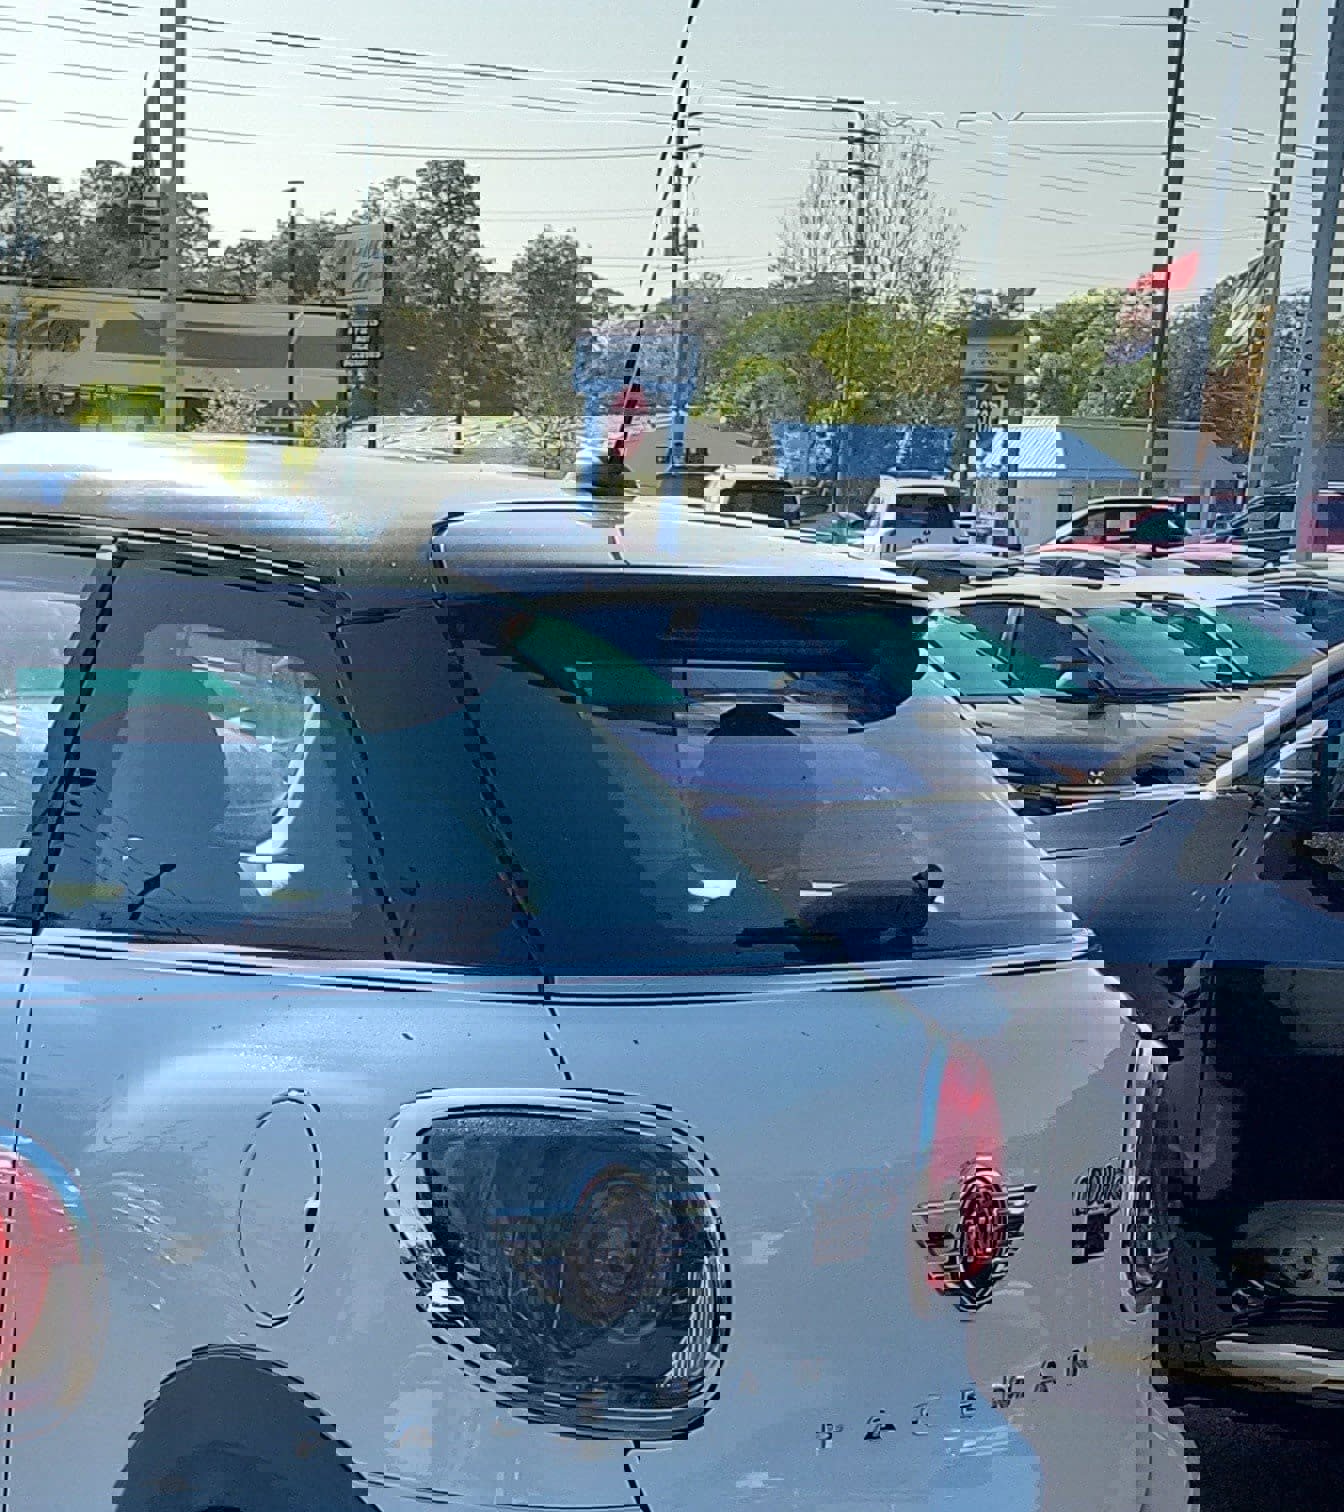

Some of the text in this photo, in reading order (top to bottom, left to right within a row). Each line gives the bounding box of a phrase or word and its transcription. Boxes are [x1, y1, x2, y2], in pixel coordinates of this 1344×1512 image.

[1246, 305, 1274, 443] LONGSTREET
[609, 407, 648, 439] STOP
[578, 1220, 648, 1266] MINI
[293, 1352, 823, 1459] PACEMAN
